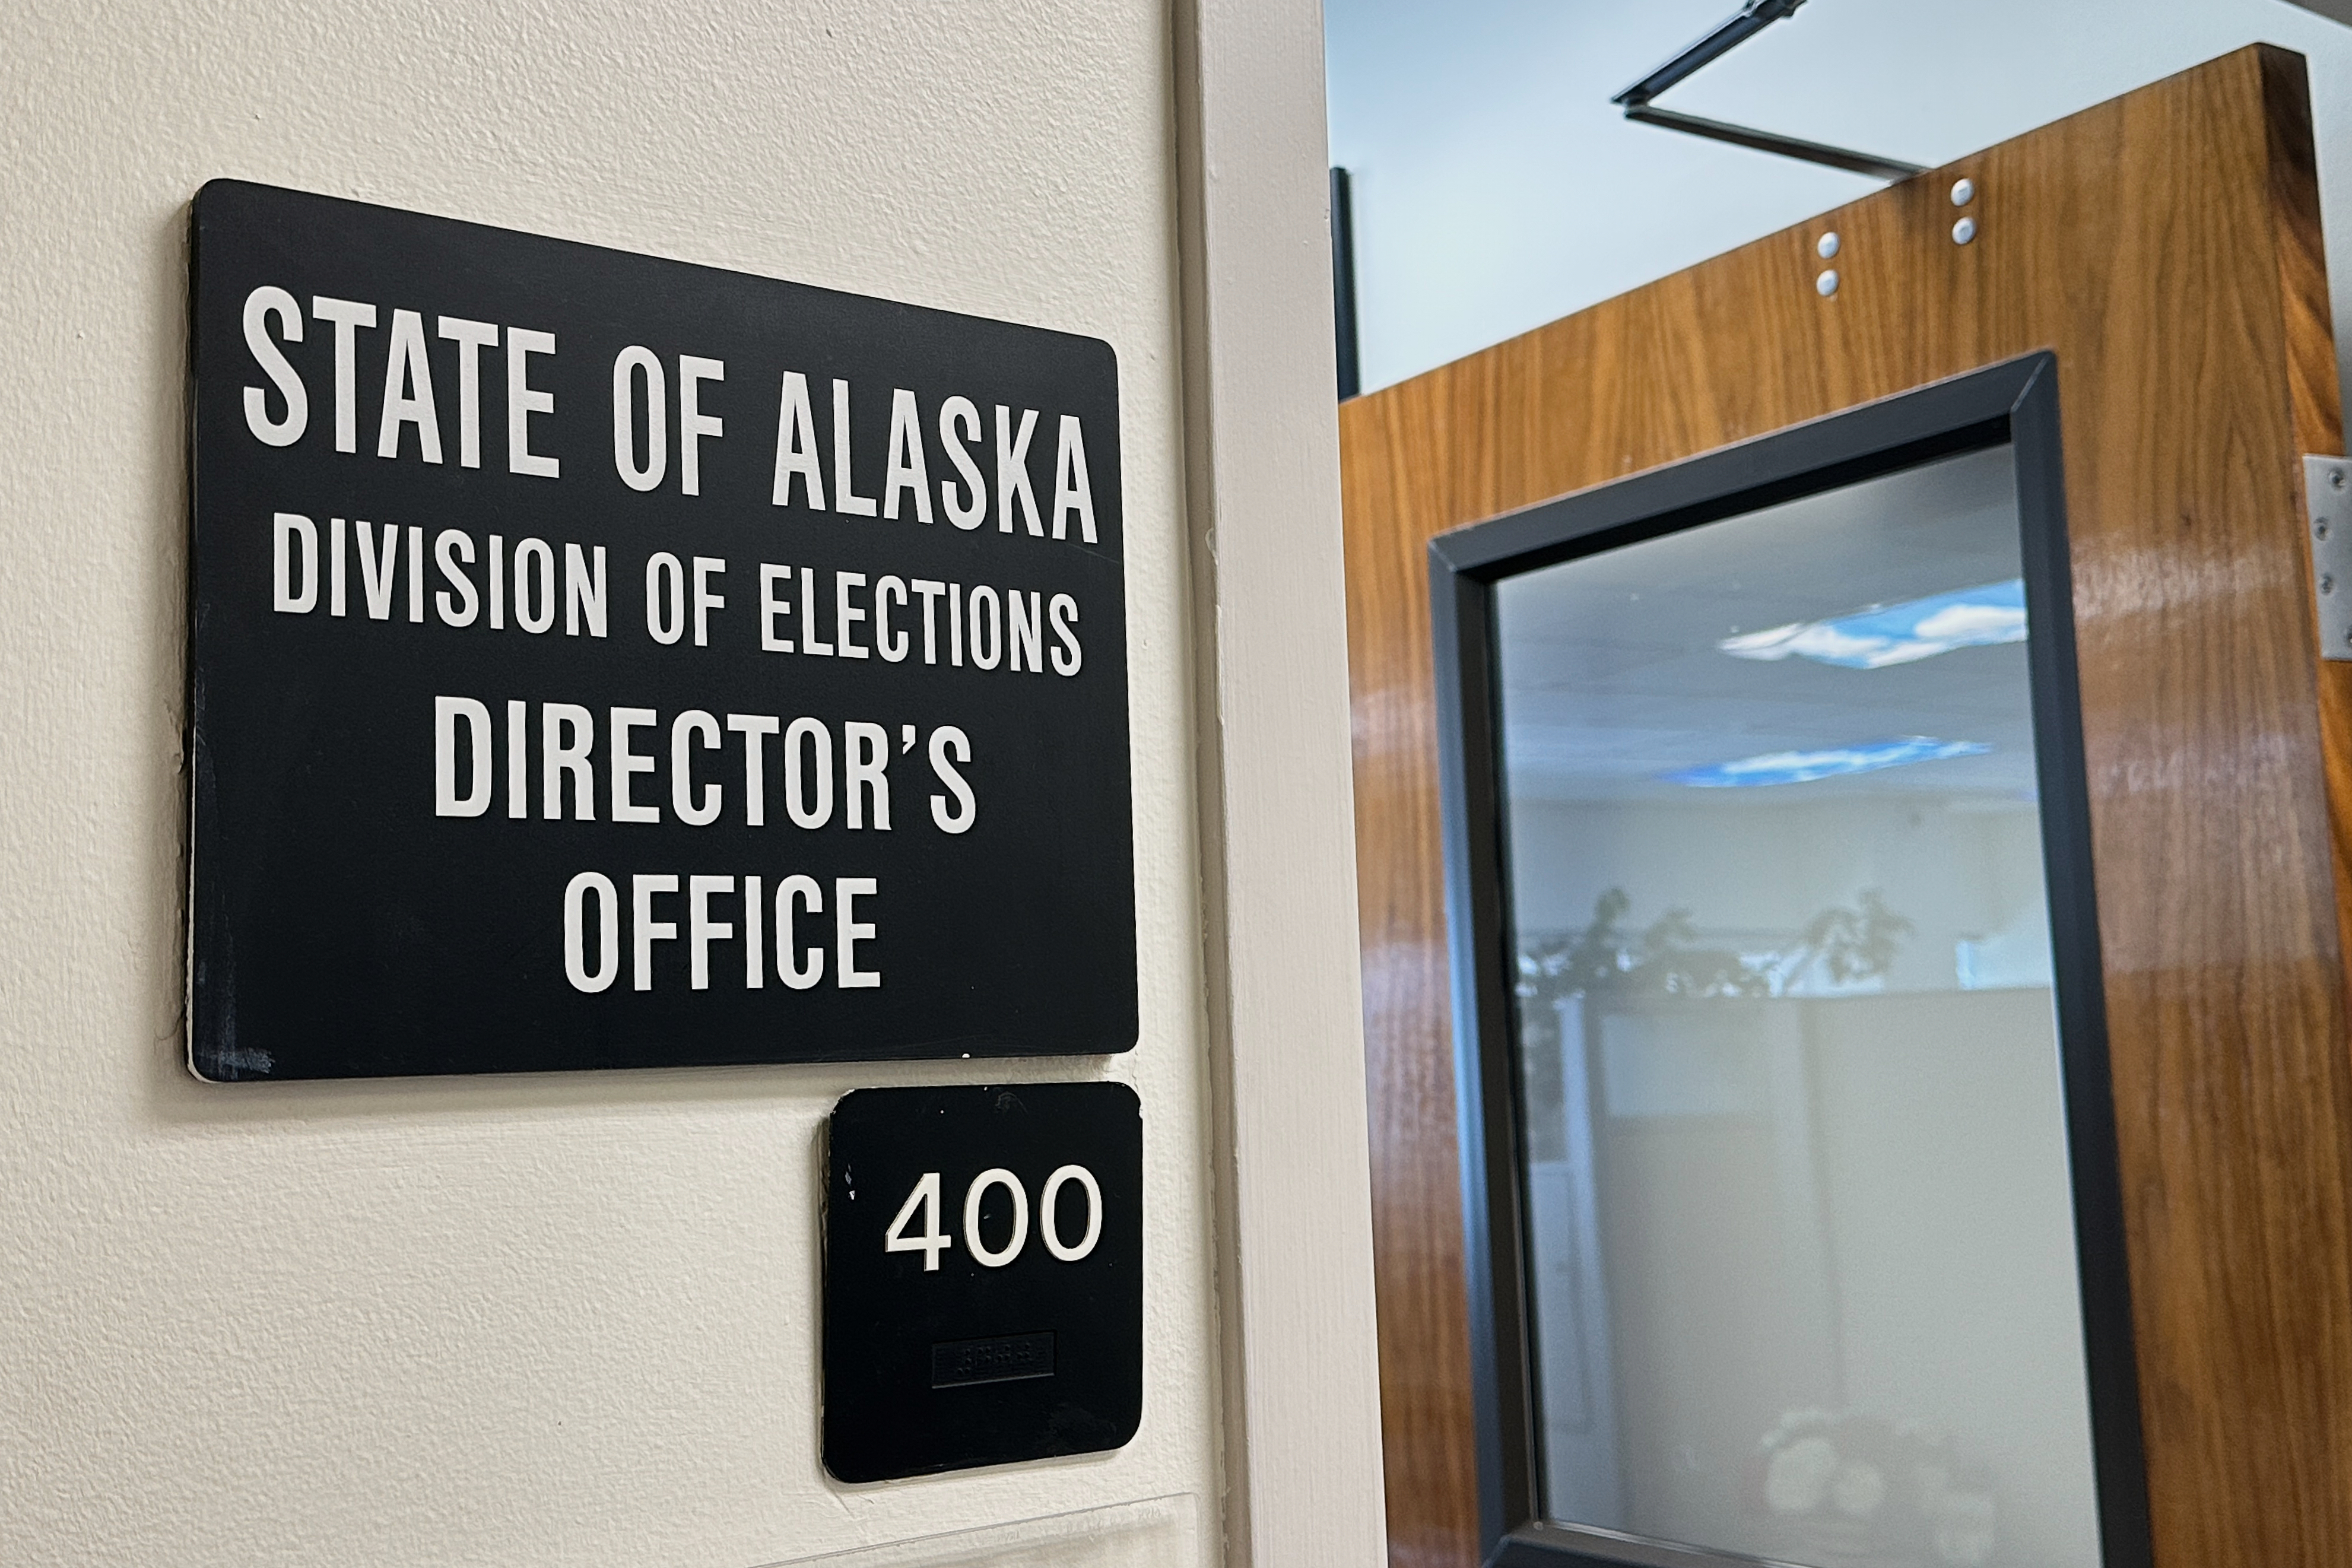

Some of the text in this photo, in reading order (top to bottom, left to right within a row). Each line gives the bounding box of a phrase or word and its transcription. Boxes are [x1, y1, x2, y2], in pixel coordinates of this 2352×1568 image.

[243, 285, 1098, 544] STATE OF ALASKA
[274, 512, 1082, 676] DIVISION OF ELECTIONS
[435, 696, 976, 834] DIRECTOR'S
[564, 871, 881, 993] OFFICE
[884, 1164, 1103, 1271] 400
